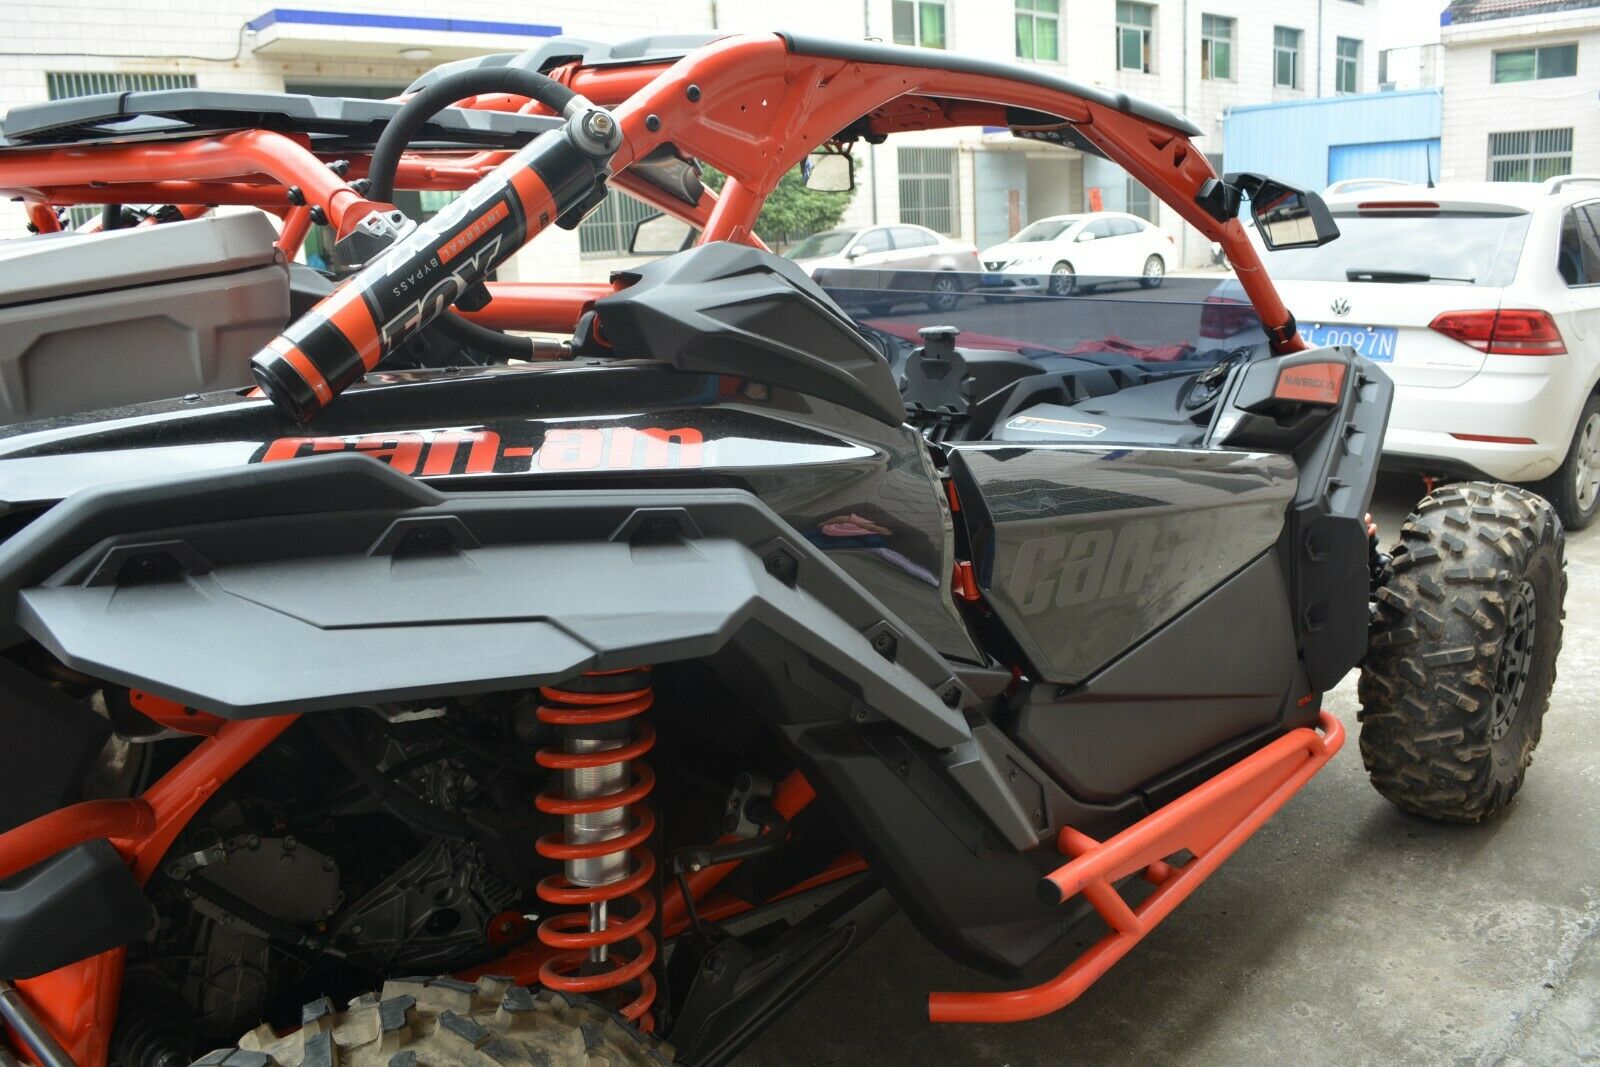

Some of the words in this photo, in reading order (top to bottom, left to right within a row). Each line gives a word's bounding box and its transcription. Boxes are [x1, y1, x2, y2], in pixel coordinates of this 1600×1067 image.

[443, 208, 502, 258] INTERNAL
[392, 257, 439, 297] BYPASS
[261, 427, 703, 475] can-am
